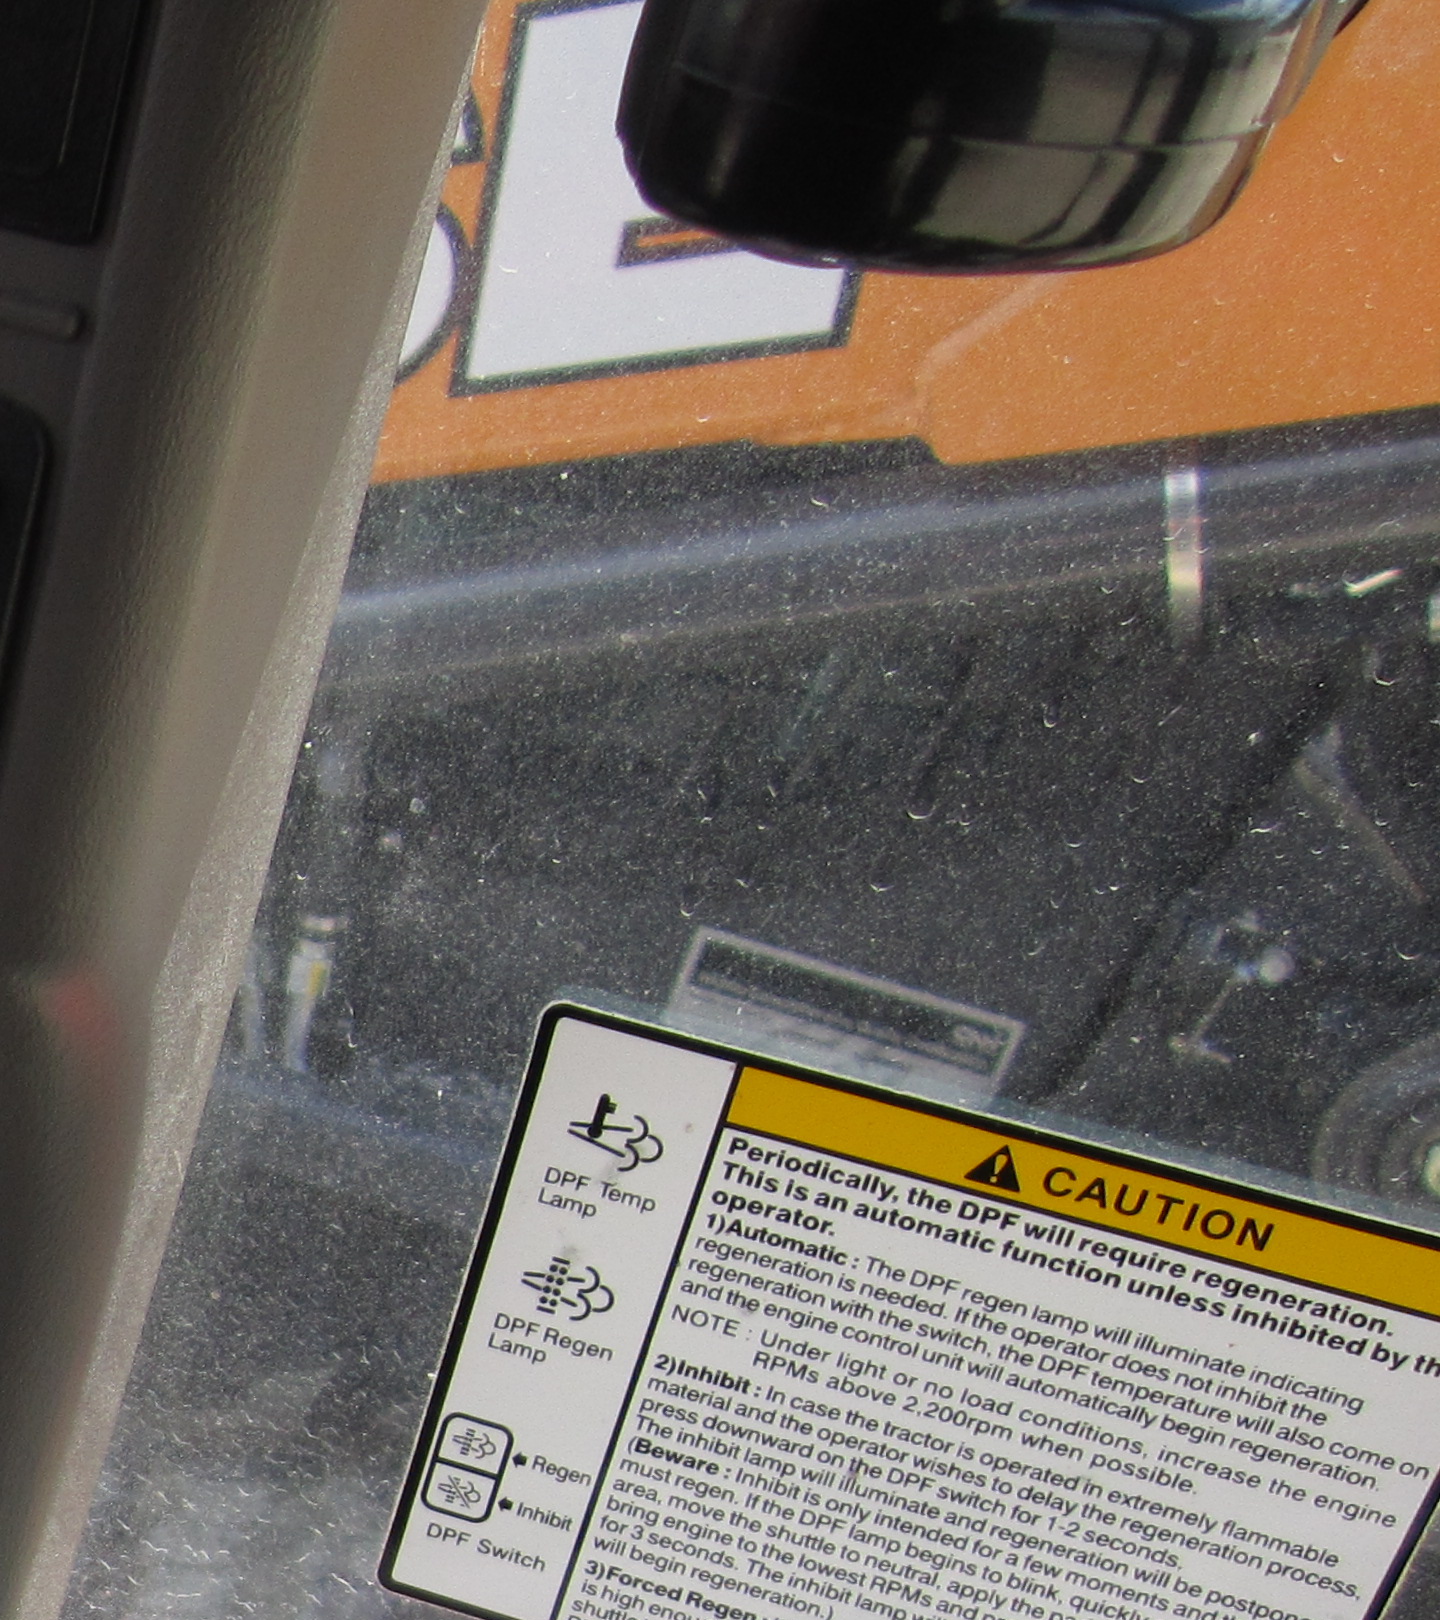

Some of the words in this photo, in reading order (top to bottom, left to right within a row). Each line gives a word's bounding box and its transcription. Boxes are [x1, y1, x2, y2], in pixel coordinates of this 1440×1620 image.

[538, 1187, 597, 1219] Lamp
[544, 1166, 591, 1191] DPF
[600, 1180, 656, 1214] Temp
[711, 1190, 835, 1237] operator.
[723, 1160, 780, 1193] This
[784, 1178, 809, 1202] is
[813, 1192, 849, 1213] an
[852, 1203, 996, 1253] automatic
[1001, 1240, 1122, 1289] function
[1127, 1278, 1227, 1318] unless
[1231, 1303, 1369, 1357] inhibited
[1370, 1342, 1411, 1371] by
[728, 1137, 899, 1204] Periodically,
[907, 1187, 952, 1214] the
[957, 1200, 1021, 1231] DPF
[1024, 1222, 1075, 1248] will
[1077, 1238, 1187, 1279] require
[1191, 1269, 1394, 1337] regeneration.
[1043, 1166, 1275, 1251] CAUTION
[488, 1332, 547, 1365] Lamp
[494, 1312, 541, 1337] DPF
[543, 1327, 613, 1361] Regen
[680, 1280, 724, 1302] and
[725, 1289, 760, 1314] the
[763, 1303, 838, 1334] engine
[841, 1326, 920, 1358] control
[921, 1349, 965, 1371] unit
[967, 1361, 1005, 1383] will
[1005, 1373, 1159, 1429] automatically
[1160, 1413, 1226, 1446] begin
[1229, 1437, 1379, 1492] regeneration.
[688, 1258, 826, 1308] regeneration
[830, 1298, 874, 1322] with
[878, 1309, 913, 1332] the
[915, 1323, 991, 1358] switch,
[998, 1344, 1034, 1367] the
[1037, 1354, 1090, 1380] DPF
[1091, 1370, 1232, 1423] temperature
[1236, 1414, 1275, 1436] will
[1275, 1426, 1325, 1450] also
[1329, 1442, 1396, 1470] come
[1399, 1462, 1429, 1480] on
[695, 1236, 834, 1287] regeneration
[837, 1273, 856, 1292] is
[859, 1283, 947, 1319] needed.
[954, 1306, 972, 1324] If
[971, 1312, 1008, 1335] the
[1010, 1327, 1111, 1364] operator
[1112, 1354, 1171, 1382] does
[1173, 1372, 1214, 1394] not
[1215, 1380, 1288, 1415] inhibit
[1290, 1403, 1328, 1426] the
[867, 1255, 906, 1282] The
[909, 1269, 961, 1296] DPF
[961, 1288, 1028, 1317] regen
[1031, 1305, 1089, 1336] lamp
[1094, 1325, 1133, 1346] will
[1133, 1332, 1246, 1378] illuminate
[1248, 1365, 1365, 1416] indicating
[531, 1455, 592, 1487] Regen
[638, 1398, 699, 1425] press
[702, 1415, 815, 1459] downward
[816, 1450, 845, 1468] on
[847, 1457, 883, 1479] the
[886, 1467, 937, 1492] DPF
[936, 1486, 1006, 1517] switch
[1010, 1504, 1042, 1526] for
[1048, 1516, 1081, 1538] 1-2
[1082, 1530, 1182, 1570] seconds.
[647, 1377, 733, 1412] material
[734, 1403, 778, 1425] and
[779, 1413, 813, 1436] the
[816, 1428, 910, 1464] operator
[913, 1455, 987, 1488] wishes
[991, 1476, 1013, 1495] to
[1017, 1485, 1079, 1517] delay
[1081, 1503, 1117, 1526] the
[1120, 1517, 1263, 1569] regeneration
[1264, 1561, 1360, 1601] process,
[671, 1304, 741, 1338] NOTE
[760, 1329, 832, 1363] Under
[836, 1352, 887, 1380] light
[893, 1372, 919, 1388] or
[923, 1381, 954, 1399] no
[960, 1387, 1014, 1417] load
[1018, 1409, 1148, 1459] conditions,
[1157, 1445, 1261, 1488] increase
[1268, 1478, 1307, 1502] the
[1314, 1495, 1397, 1528] engine
[752, 1350, 819, 1384] RPMs
[825, 1376, 897, 1406] above
[902, 1395, 1013, 1441] 2,200rpm
[1021, 1432, 1084, 1462] when
[1088, 1453, 1197, 1495] possible.
[765, 1385, 786, 1405] In
[789, 1396, 841, 1421] case
[845, 1409, 879, 1432] the
[883, 1420, 955, 1454] tractor
[956, 1441, 975, 1461] is
[979, 1452, 1082, 1492] operated
[1082, 1478, 1103, 1499] in
[1107, 1490, 1218, 1535] extremely
[1221, 1519, 1339, 1568] flammable
[426, 1522, 472, 1546] DPF
[477, 1538, 545, 1572] Switch
[516, 1502, 573, 1532] Inhibit
[636, 1413, 673, 1440] The
[676, 1427, 742, 1460] inhibit
[743, 1447, 796, 1479] lamp
[801, 1467, 836, 1488] will
[838, 1475, 941, 1519] illuminate
[943, 1511, 988, 1534] and
[989, 1525, 1129, 1577] regeneration
[1134, 1567, 1172, 1588] will
[1172, 1576, 1203, 1598] be
